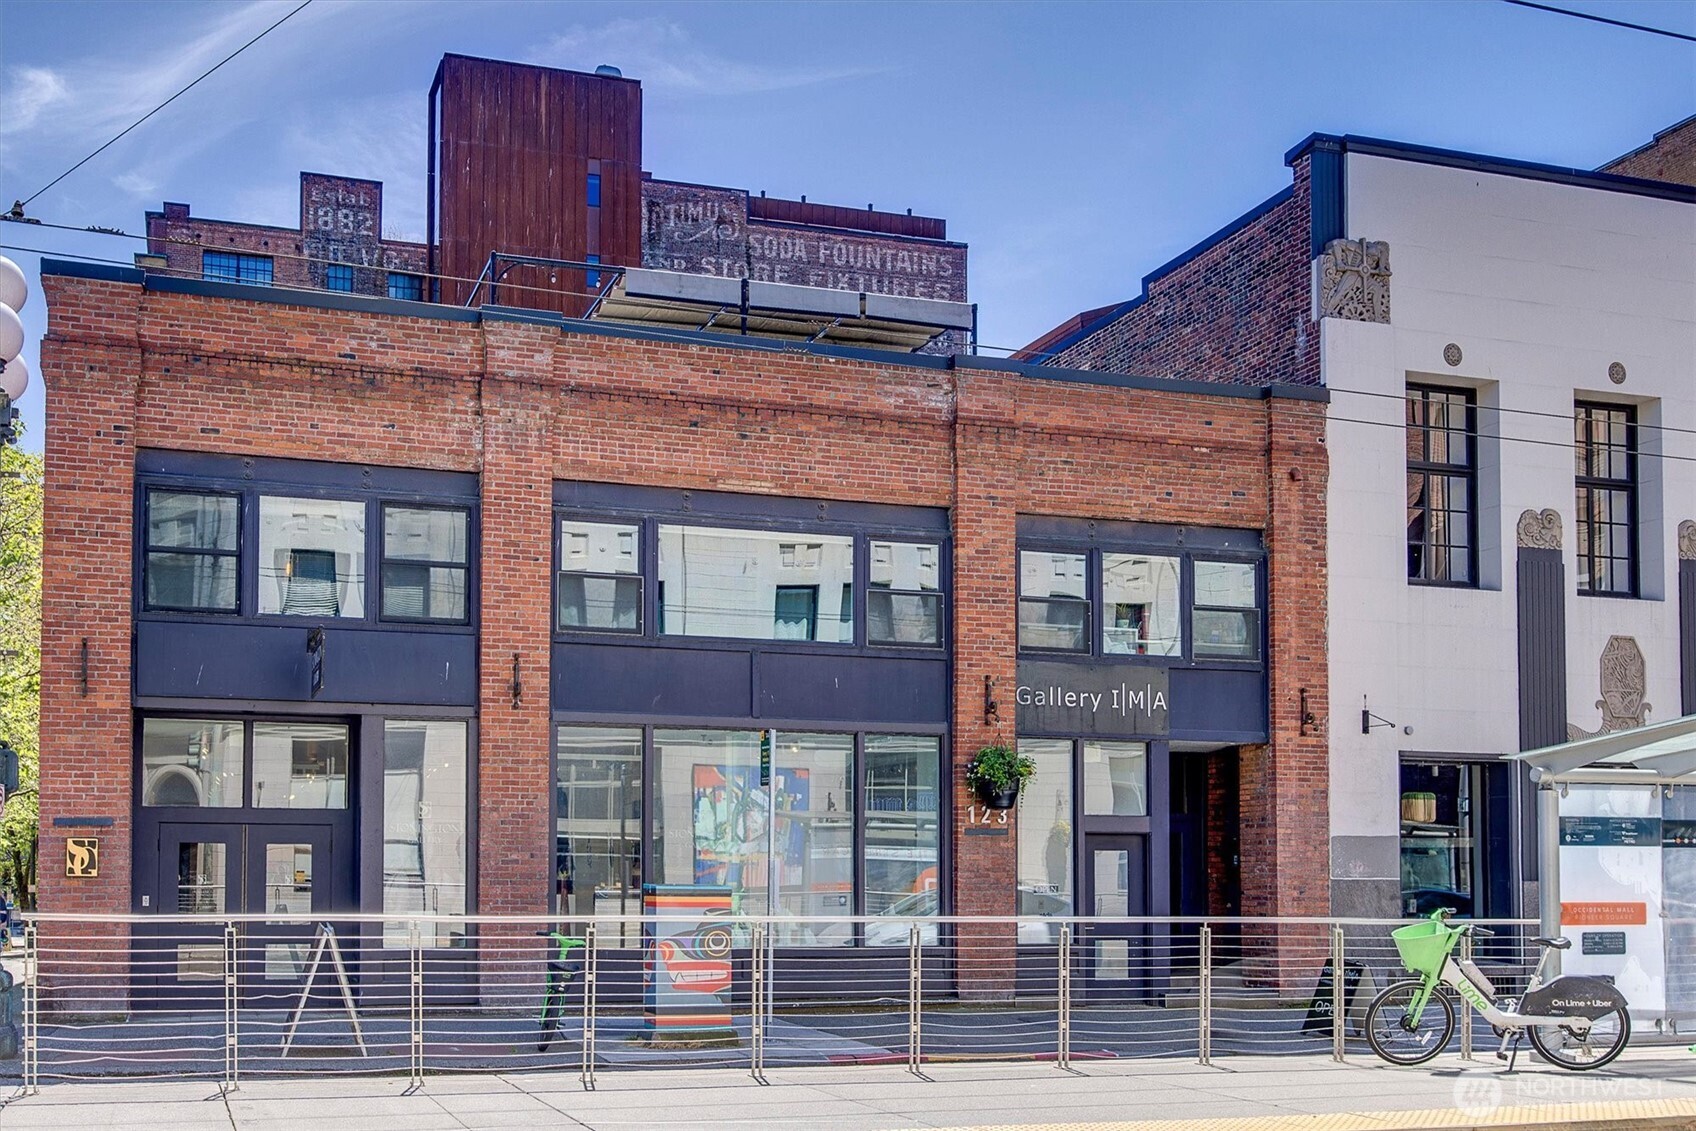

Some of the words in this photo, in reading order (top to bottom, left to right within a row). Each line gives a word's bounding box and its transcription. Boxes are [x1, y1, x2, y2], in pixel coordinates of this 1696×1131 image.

[306, 207, 374, 236] 1882
[749, 233, 808, 262] SODA
[818, 240, 953, 277] FOUNTAINS
[1016, 686, 1102, 712] Gallery
[967, 806, 1008, 824] 123
[1552, 999, 1564, 1007] On
[1566, 999, 1586, 1007] Lime
[1593, 999, 1612, 1007] Uber
